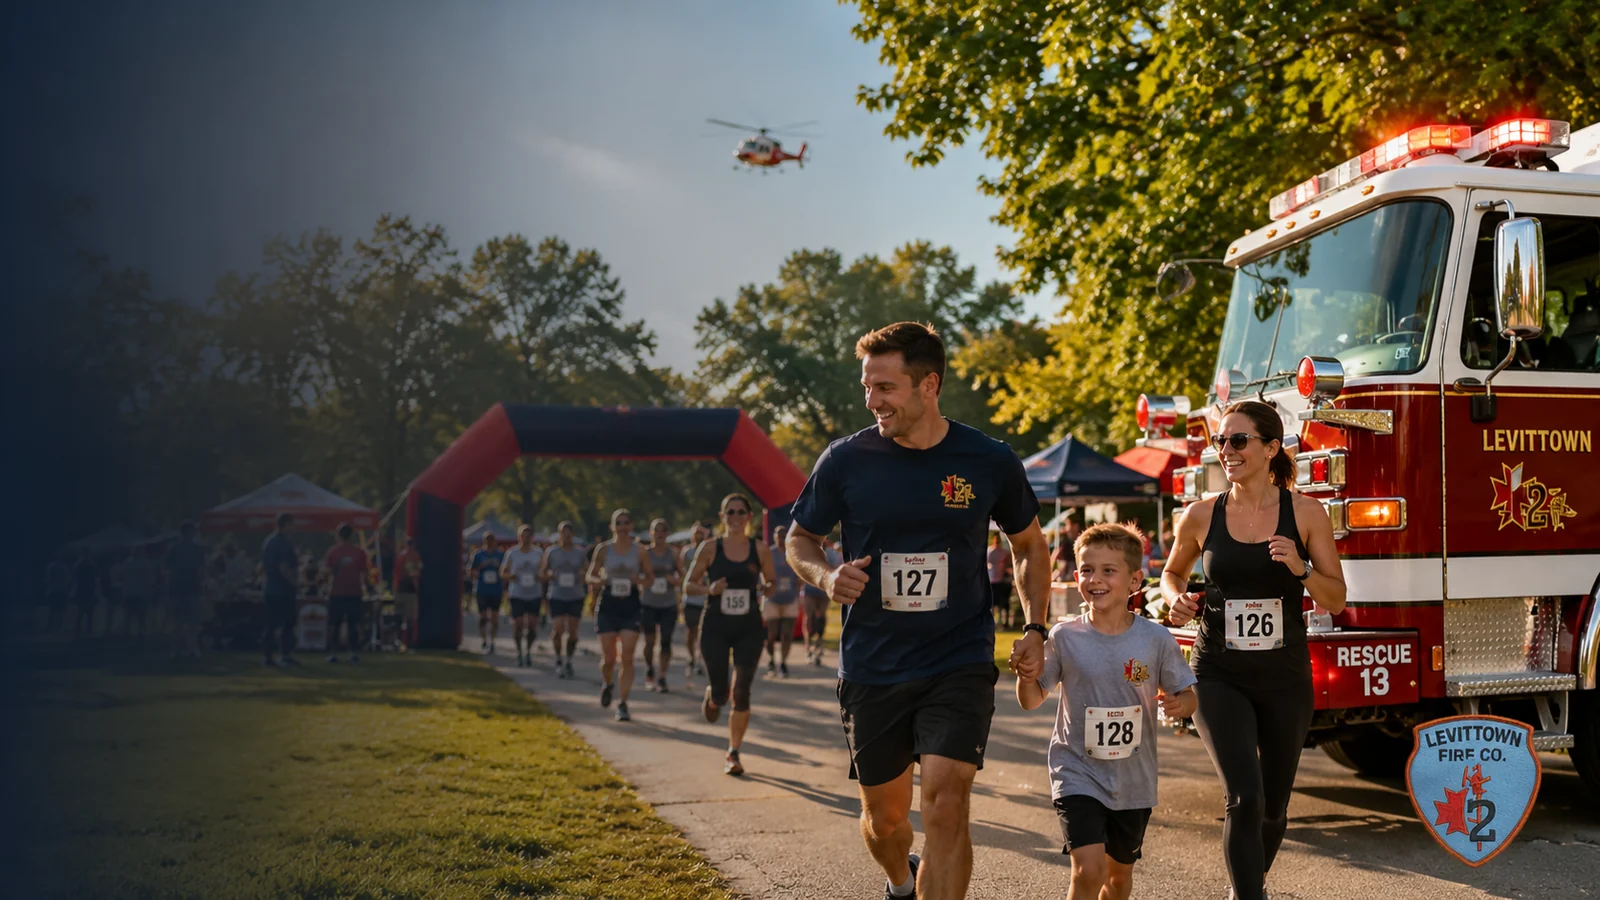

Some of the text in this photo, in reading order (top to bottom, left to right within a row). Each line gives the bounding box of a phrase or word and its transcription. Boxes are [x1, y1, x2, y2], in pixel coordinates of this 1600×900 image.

[1482, 429, 1592, 453] LEVITTOWN
[1526, 481, 1548, 529] 2
[893, 569, 937, 596] 127
[1235, 613, 1274, 637] 126
[1337, 643, 1412, 667] RESCUE
[1360, 666, 1390, 697] 13
[1095, 720, 1134, 747] 128
